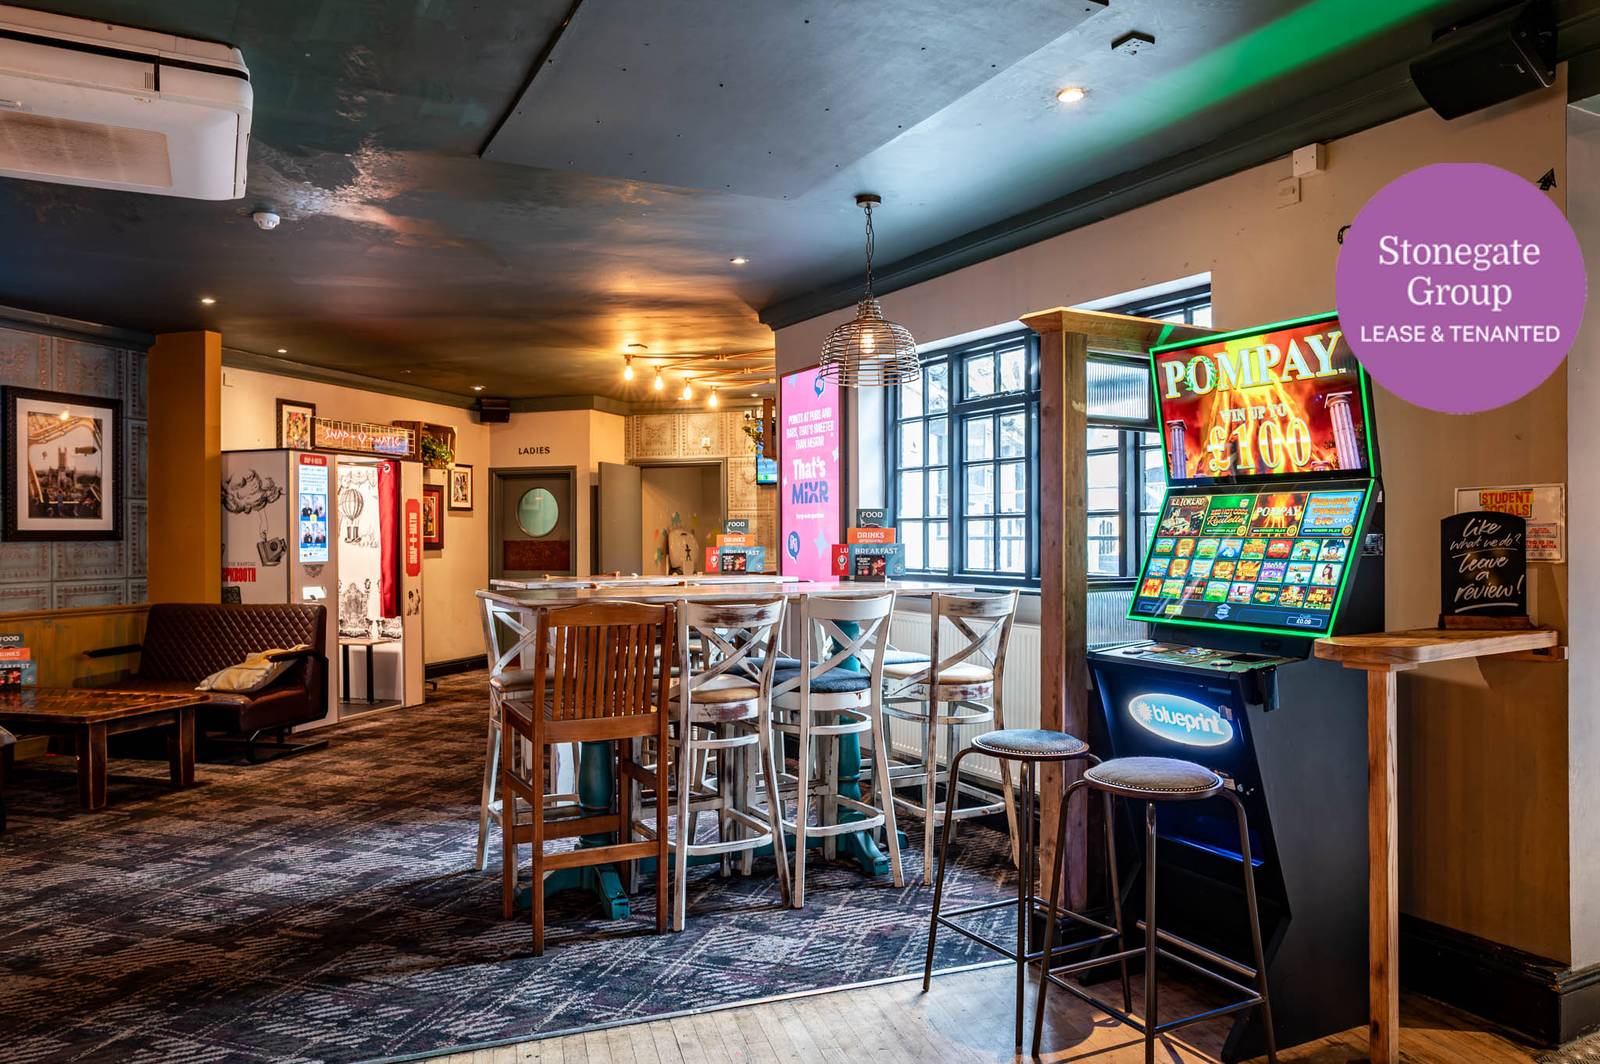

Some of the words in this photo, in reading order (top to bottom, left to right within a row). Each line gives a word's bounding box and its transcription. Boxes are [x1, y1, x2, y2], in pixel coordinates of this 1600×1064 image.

[1161, 331, 1344, 399] POMPAY
[1220, 408, 1246, 422] WIN
[1250, 406, 1267, 420] UP
[1269, 402, 1289, 418] TO
[518, 446, 551, 456] LADIES
[1207, 418, 1312, 473] £100
[792, 456, 826, 480] That's
[1481, 491, 1532, 505] STUDENT
[856, 531, 885, 539] DRINKS
[854, 547, 898, 555] BREAKFAST
[1450, 537, 1482, 551] what
[1475, 570, 1490, 582] a
[1151, 703, 1225, 736] blueprint
